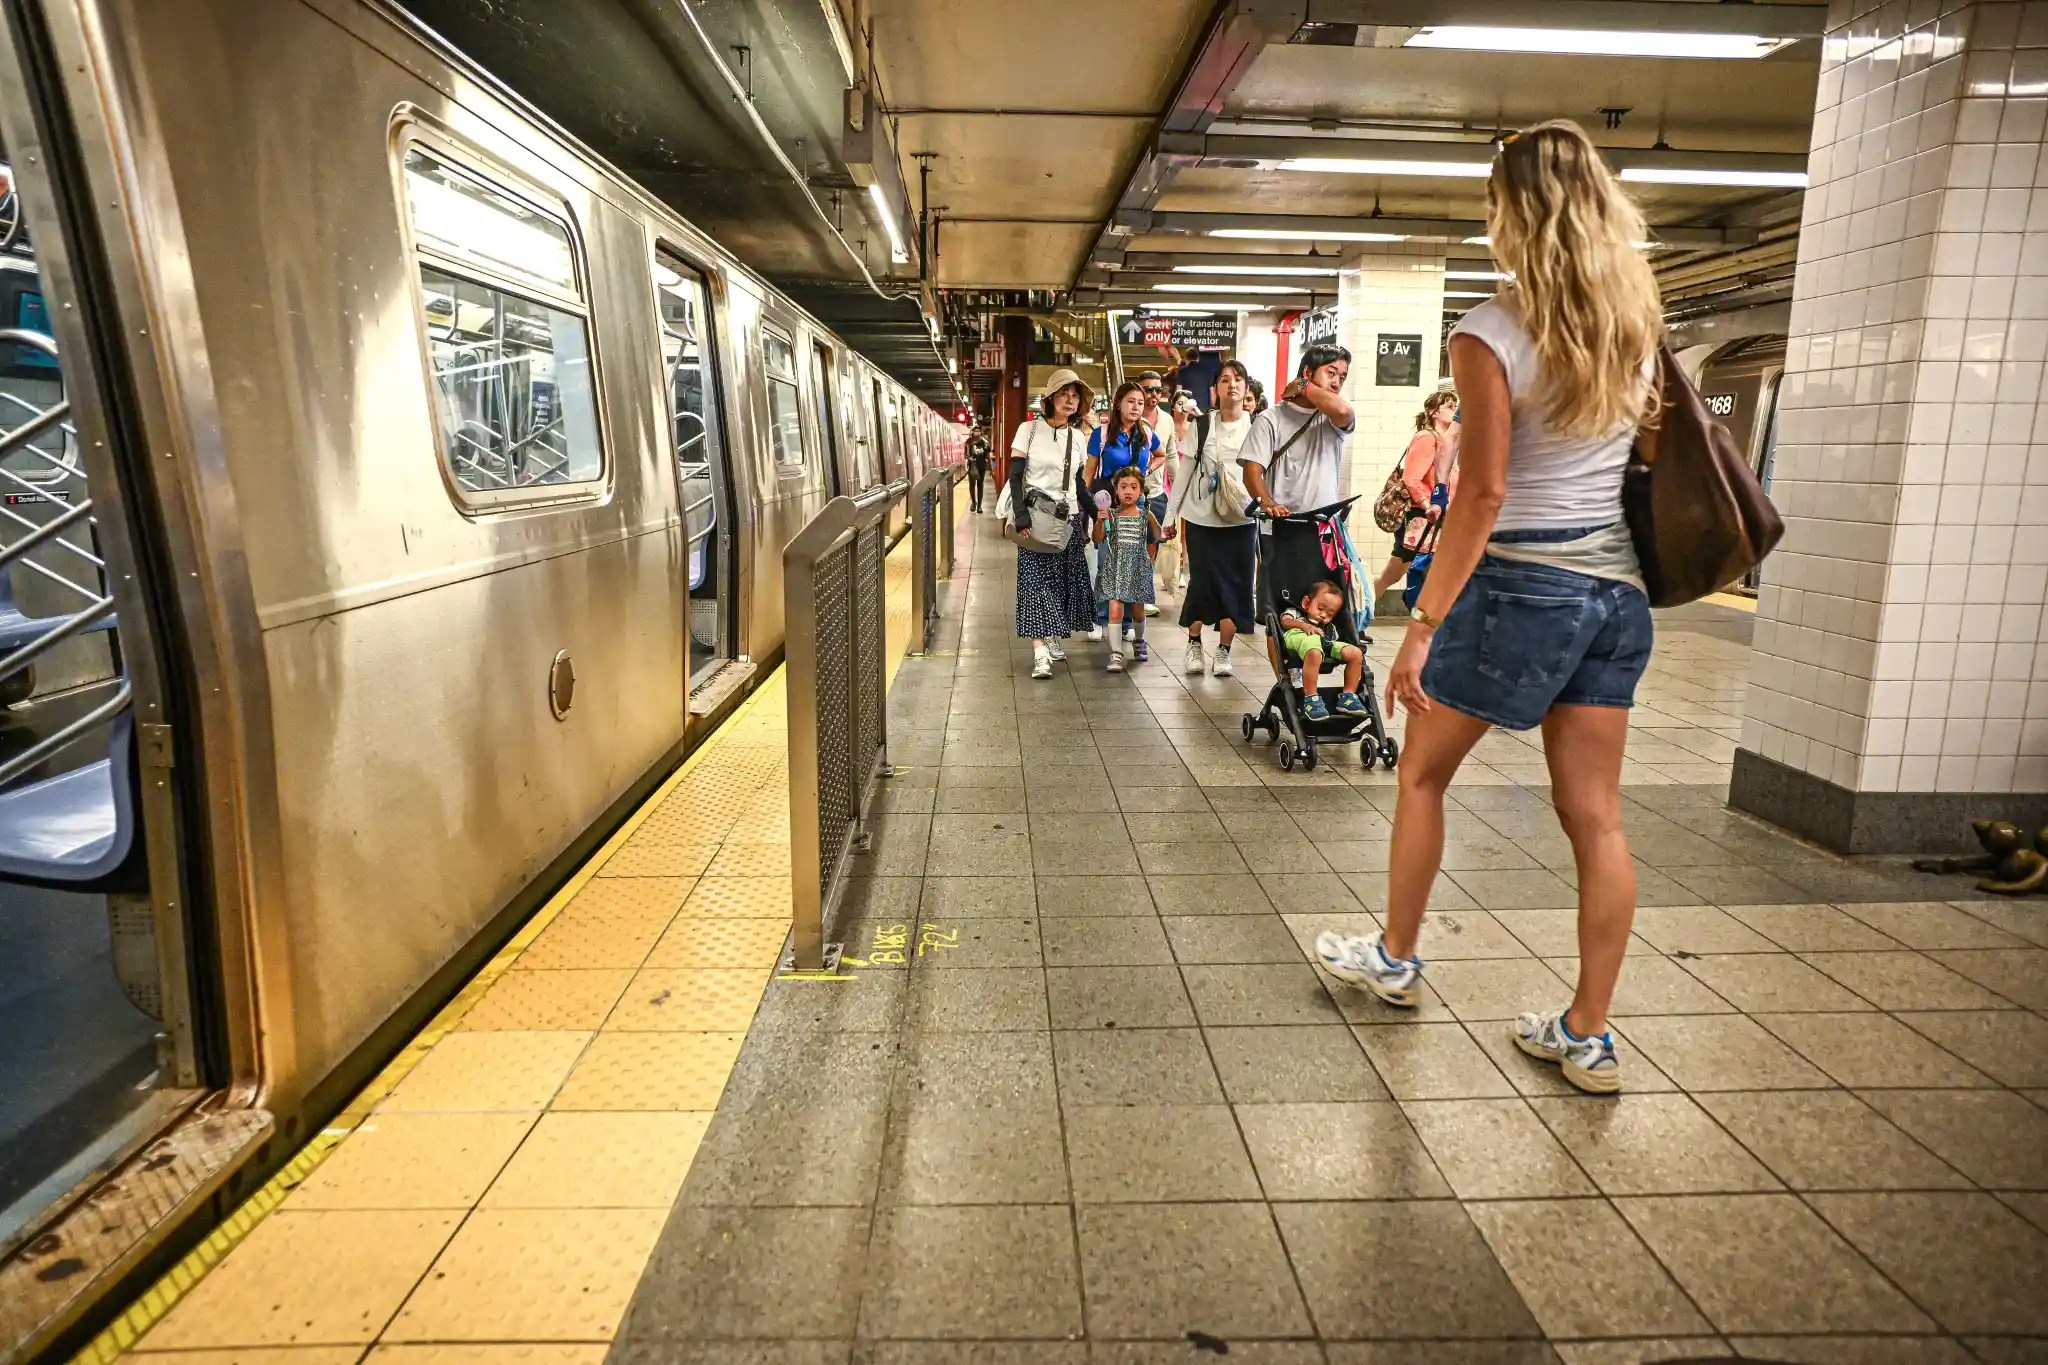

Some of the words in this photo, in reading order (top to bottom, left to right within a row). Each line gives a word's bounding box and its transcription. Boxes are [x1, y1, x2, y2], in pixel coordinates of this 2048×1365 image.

[1145, 319, 1171, 330] Exit
[1172, 319, 1186, 328] For
[1190, 319, 1224, 329] transfer
[1226, 321, 1238, 329] us
[1300, 319, 1306, 345] 8
[1308, 314, 1338, 343] Avenue
[1145, 332, 1171, 345] only
[1172, 328, 1195, 336] other
[1198, 328, 1235, 339] stairway
[1183, 336, 1219, 345] elevator
[1379, 341, 1389, 355] 8
[1393, 342, 1410, 355] Av
[980, 349, 1002, 368] EXIT
